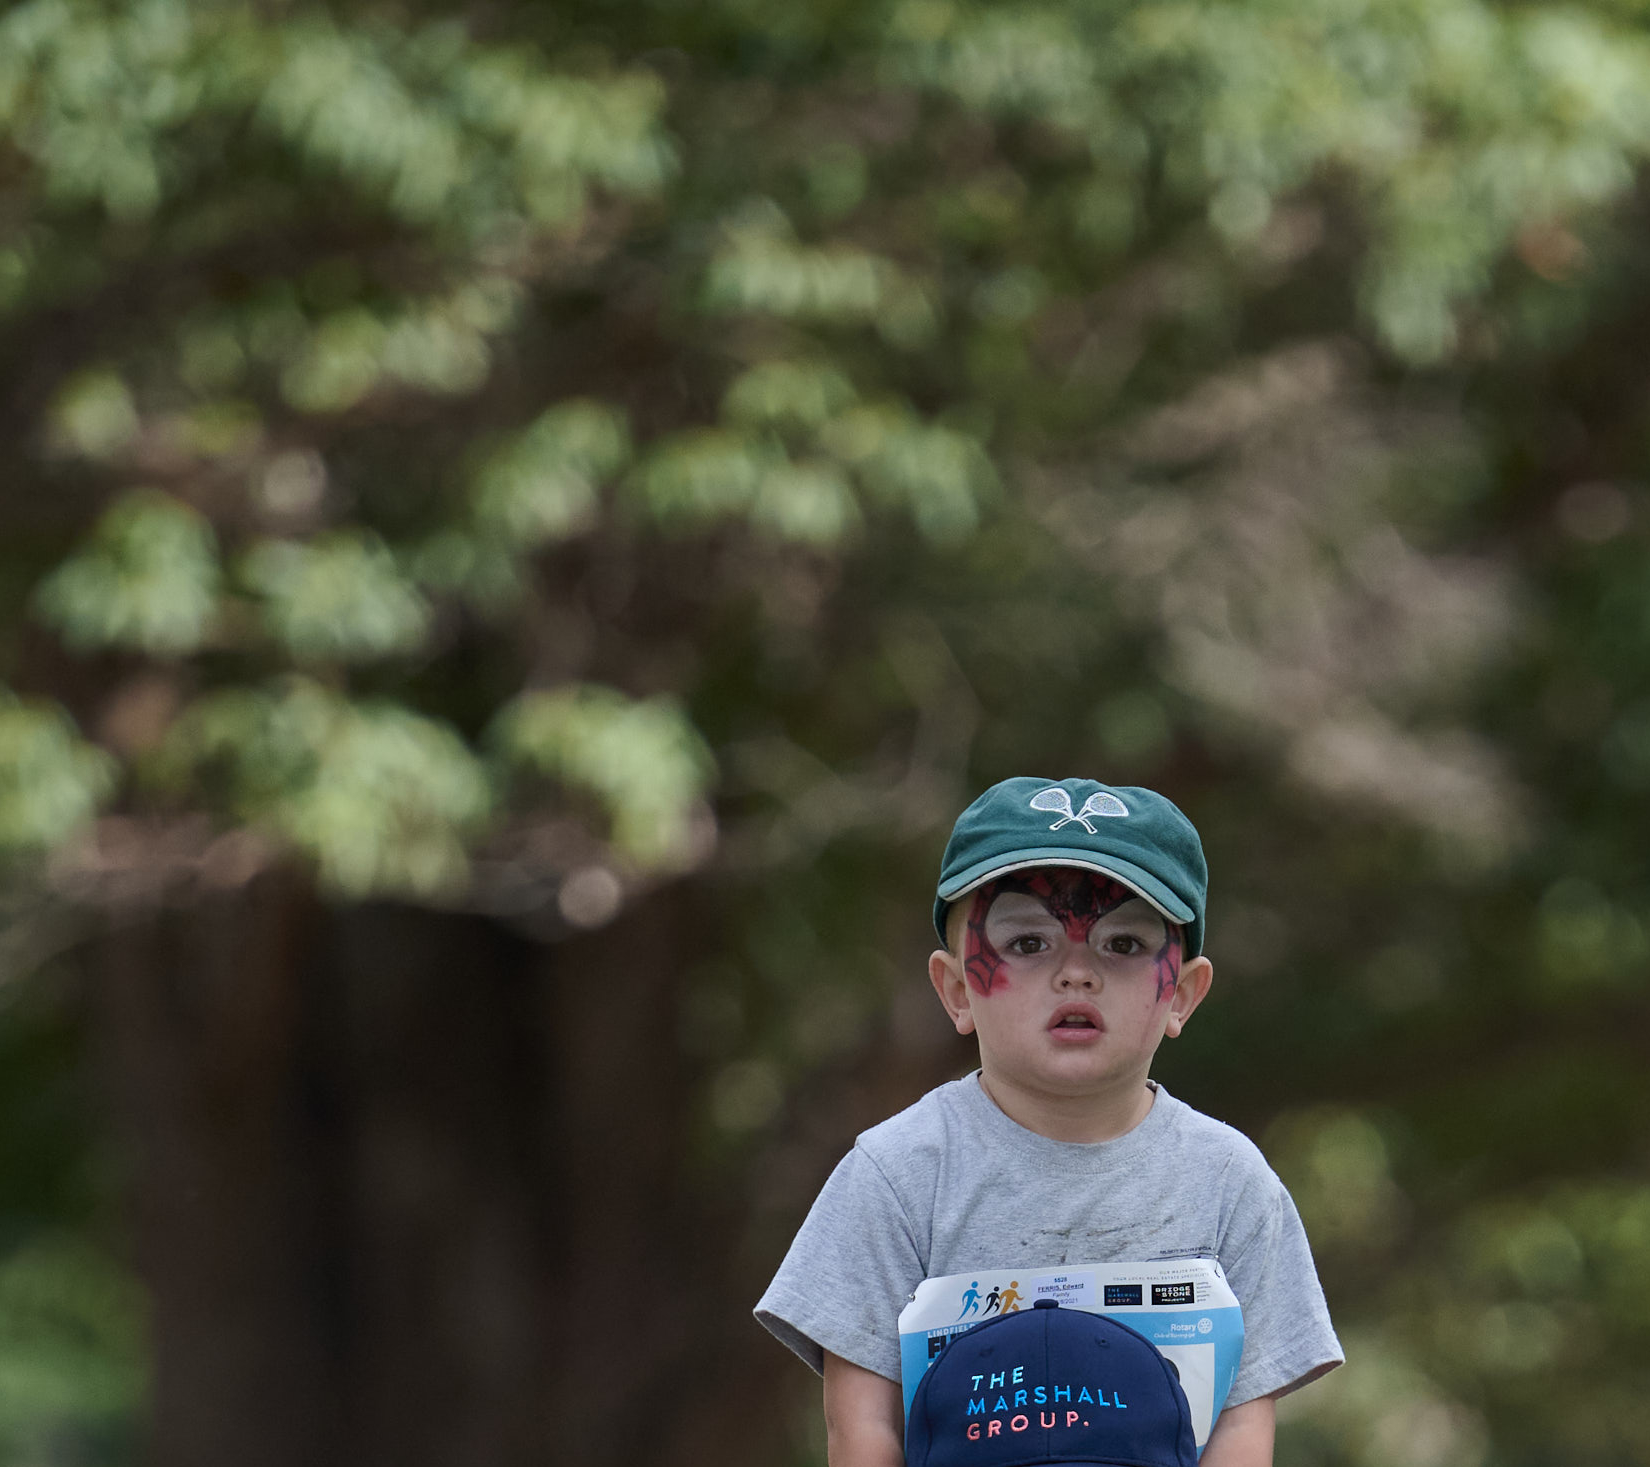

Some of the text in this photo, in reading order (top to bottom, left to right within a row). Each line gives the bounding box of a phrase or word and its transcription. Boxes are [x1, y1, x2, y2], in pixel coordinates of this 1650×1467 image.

[1170, 1323, 1196, 1332] Rotary
[971, 1365, 1025, 1392] THE
[966, 1384, 1128, 1416] MARSHALL
[966, 1410, 1090, 1441] GROUP.
